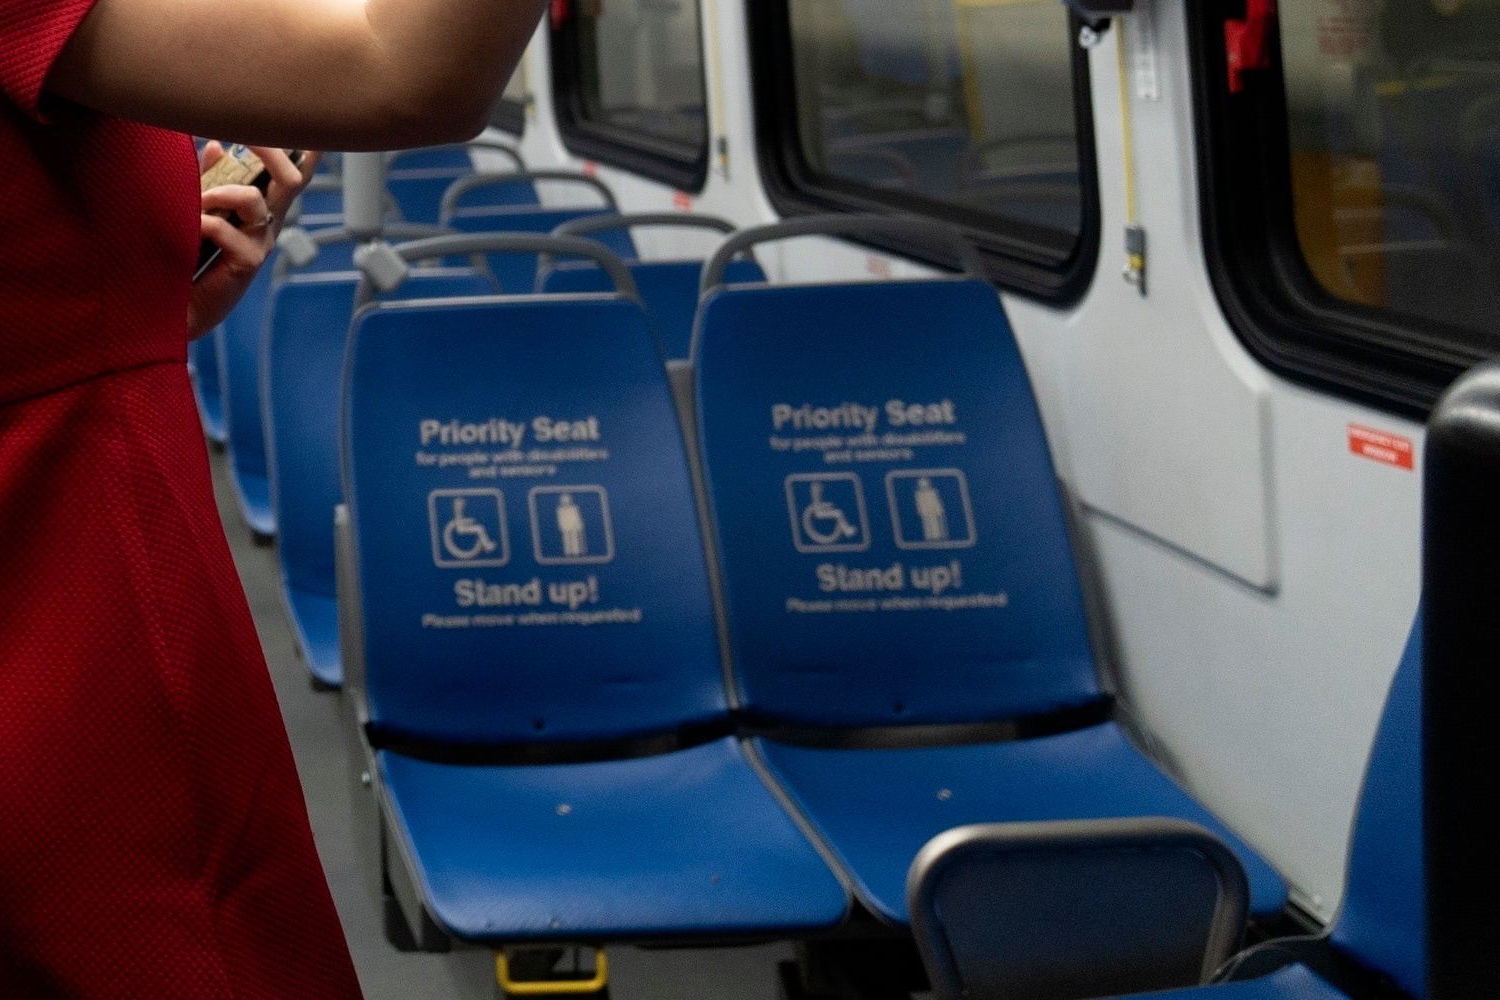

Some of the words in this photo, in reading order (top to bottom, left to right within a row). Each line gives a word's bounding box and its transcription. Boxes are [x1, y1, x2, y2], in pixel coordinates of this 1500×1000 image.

[419, 418, 525, 450] Priority
[531, 416, 600, 442] Seat
[771, 403, 878, 434] Priority
[884, 399, 956, 426] Seat
[454, 577, 541, 607] Stand
[549, 574, 599, 610] up!
[816, 563, 903, 592] Stand
[911, 559, 962, 594] up!
